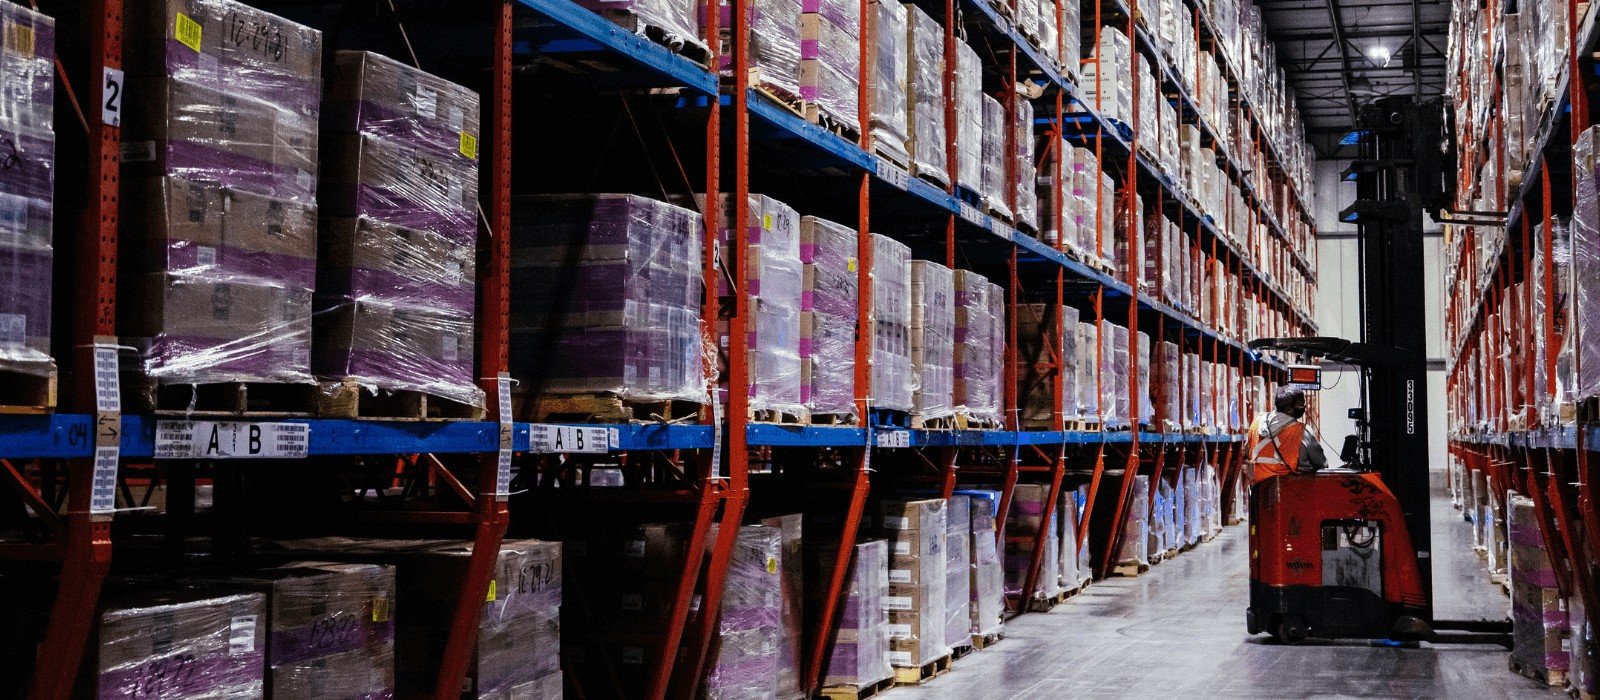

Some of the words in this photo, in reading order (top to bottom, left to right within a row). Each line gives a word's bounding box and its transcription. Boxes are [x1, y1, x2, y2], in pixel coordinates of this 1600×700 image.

[105, 80, 119, 112] 2
[714, 246, 719, 263] 2
[206, 424, 220, 454] A
[249, 424, 262, 454] B
[556, 427, 563, 450] A
[576, 428, 584, 450] B
